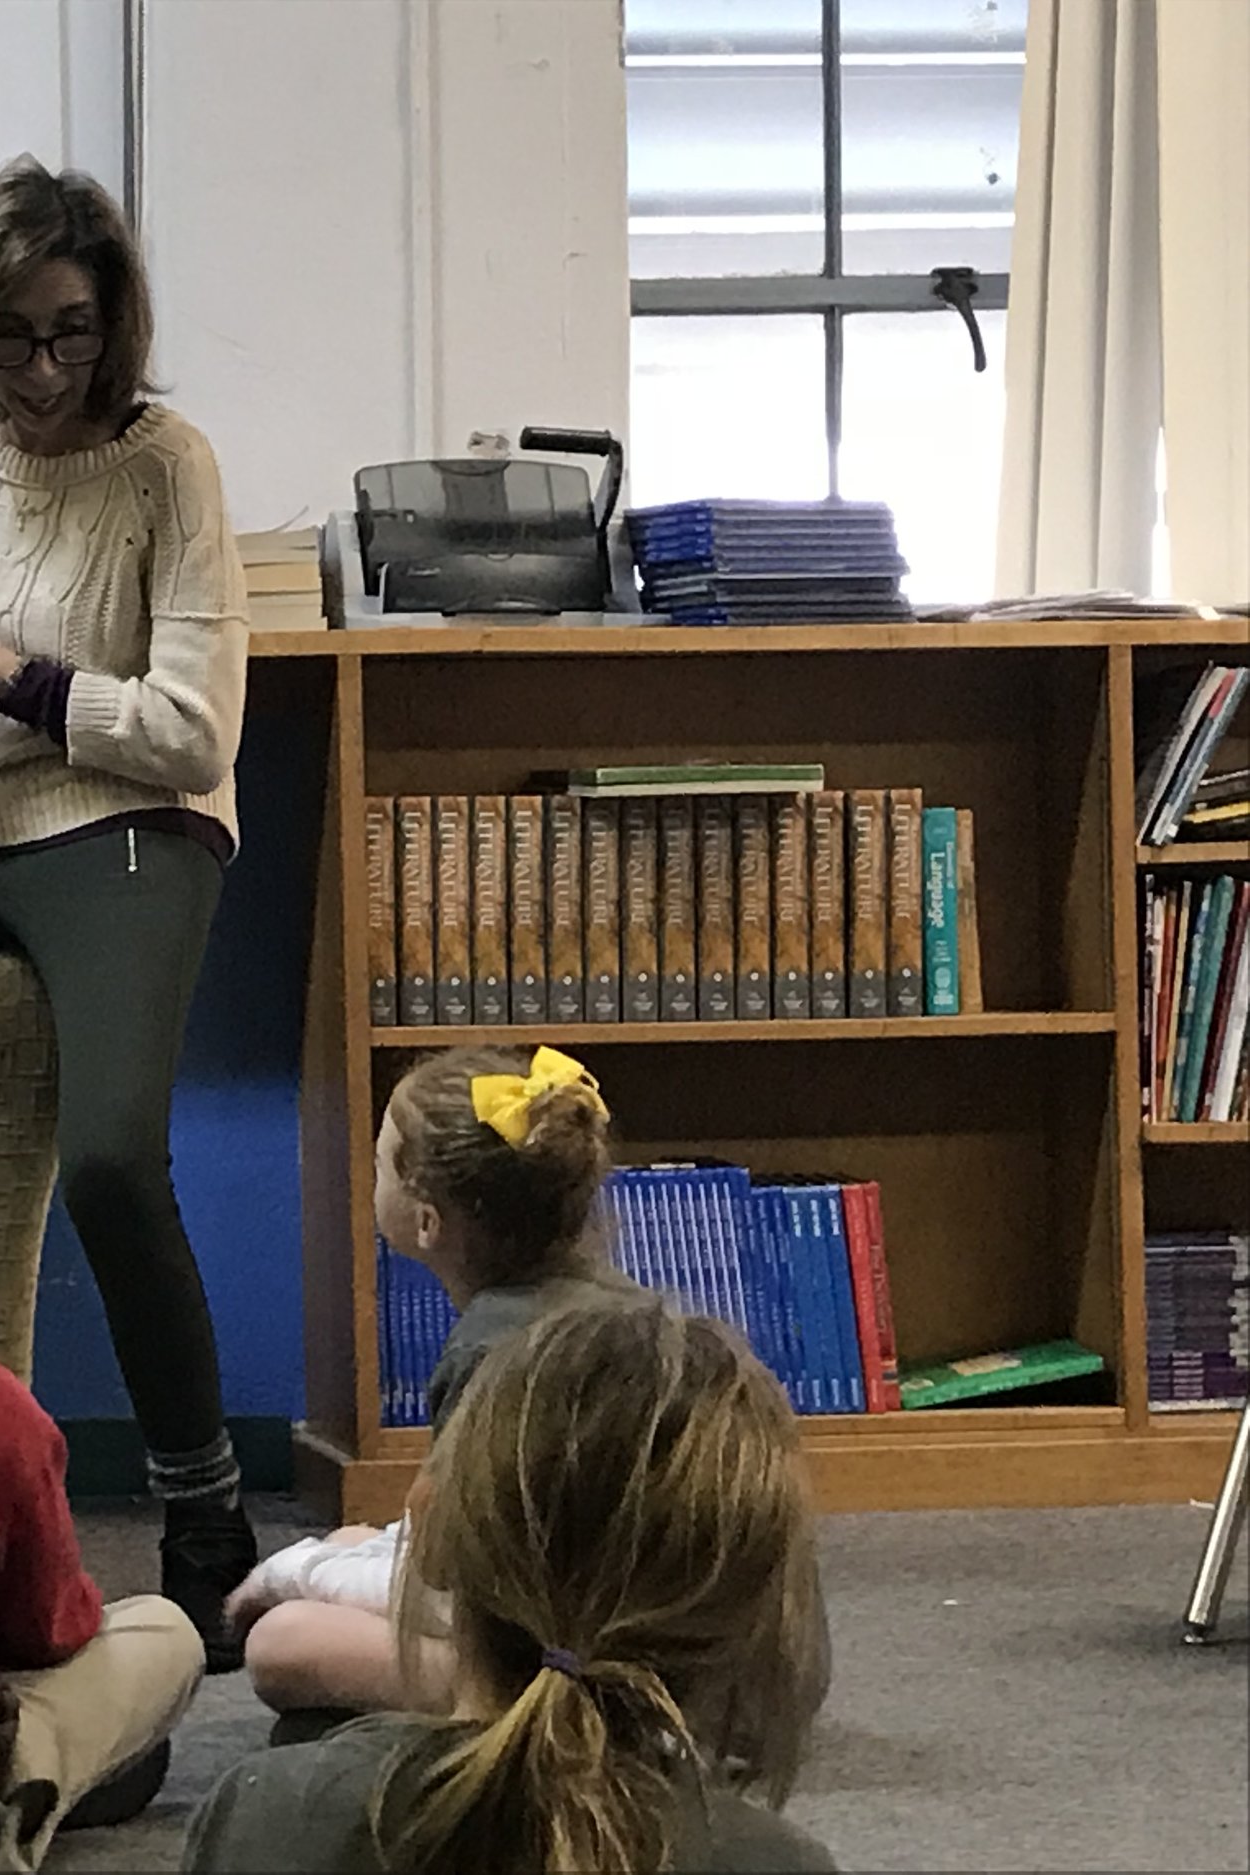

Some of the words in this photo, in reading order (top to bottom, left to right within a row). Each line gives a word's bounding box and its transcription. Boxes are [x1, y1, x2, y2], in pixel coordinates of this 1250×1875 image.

[367, 813, 383, 928] LITERATURE
[401, 812, 421, 926] LITERATURE
[439, 812, 458, 926] LITERATURE
[477, 812, 495, 926] LITERATURE
[514, 810, 532, 925] LITERATURE
[552, 811, 572, 926] LITERATURE
[777, 807, 794, 922] LITERATURE
[814, 807, 833, 921] LITERATURE
[854, 805, 874, 920] LITERATURE
[892, 804, 911, 918] LITERATURE
[927, 852, 945, 928] Language
